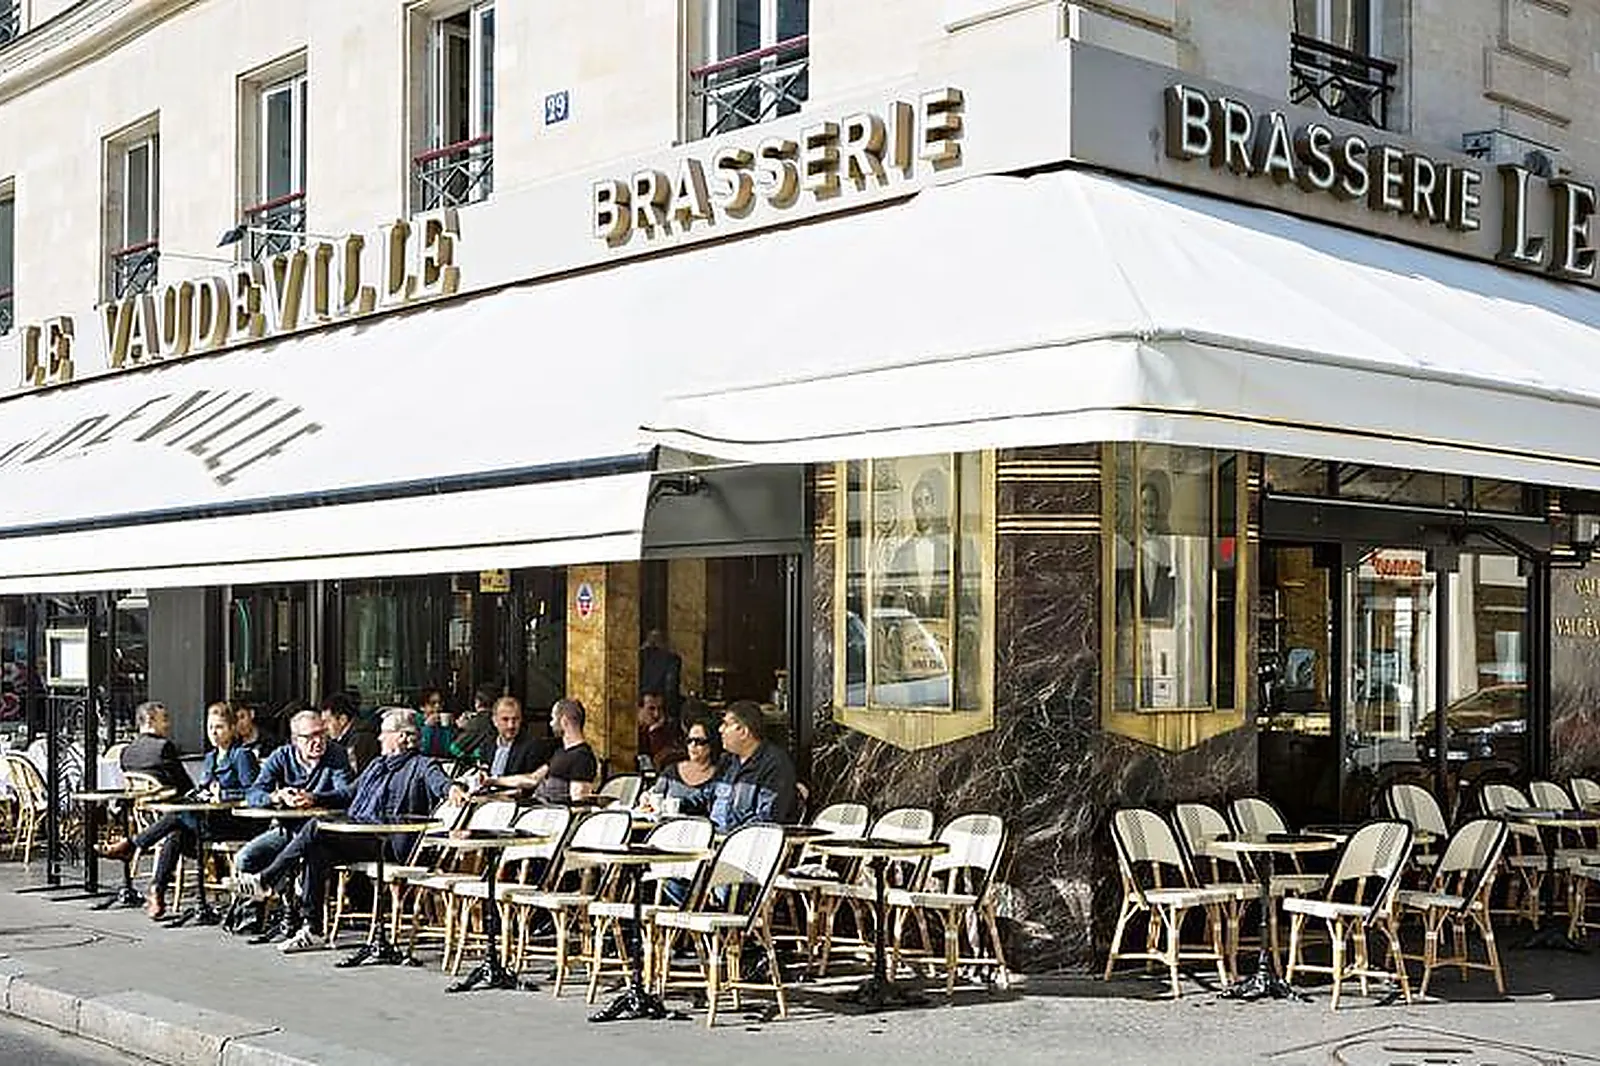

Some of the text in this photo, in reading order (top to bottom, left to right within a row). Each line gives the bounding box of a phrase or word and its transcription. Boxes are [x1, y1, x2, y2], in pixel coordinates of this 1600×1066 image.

[547, 94, 566, 121] 29
[593, 87, 967, 247] BRASSERIE
[1172, 88, 1595, 277] BRASSERIE LE
[20, 208, 463, 387] LE VAUDEVILLE
